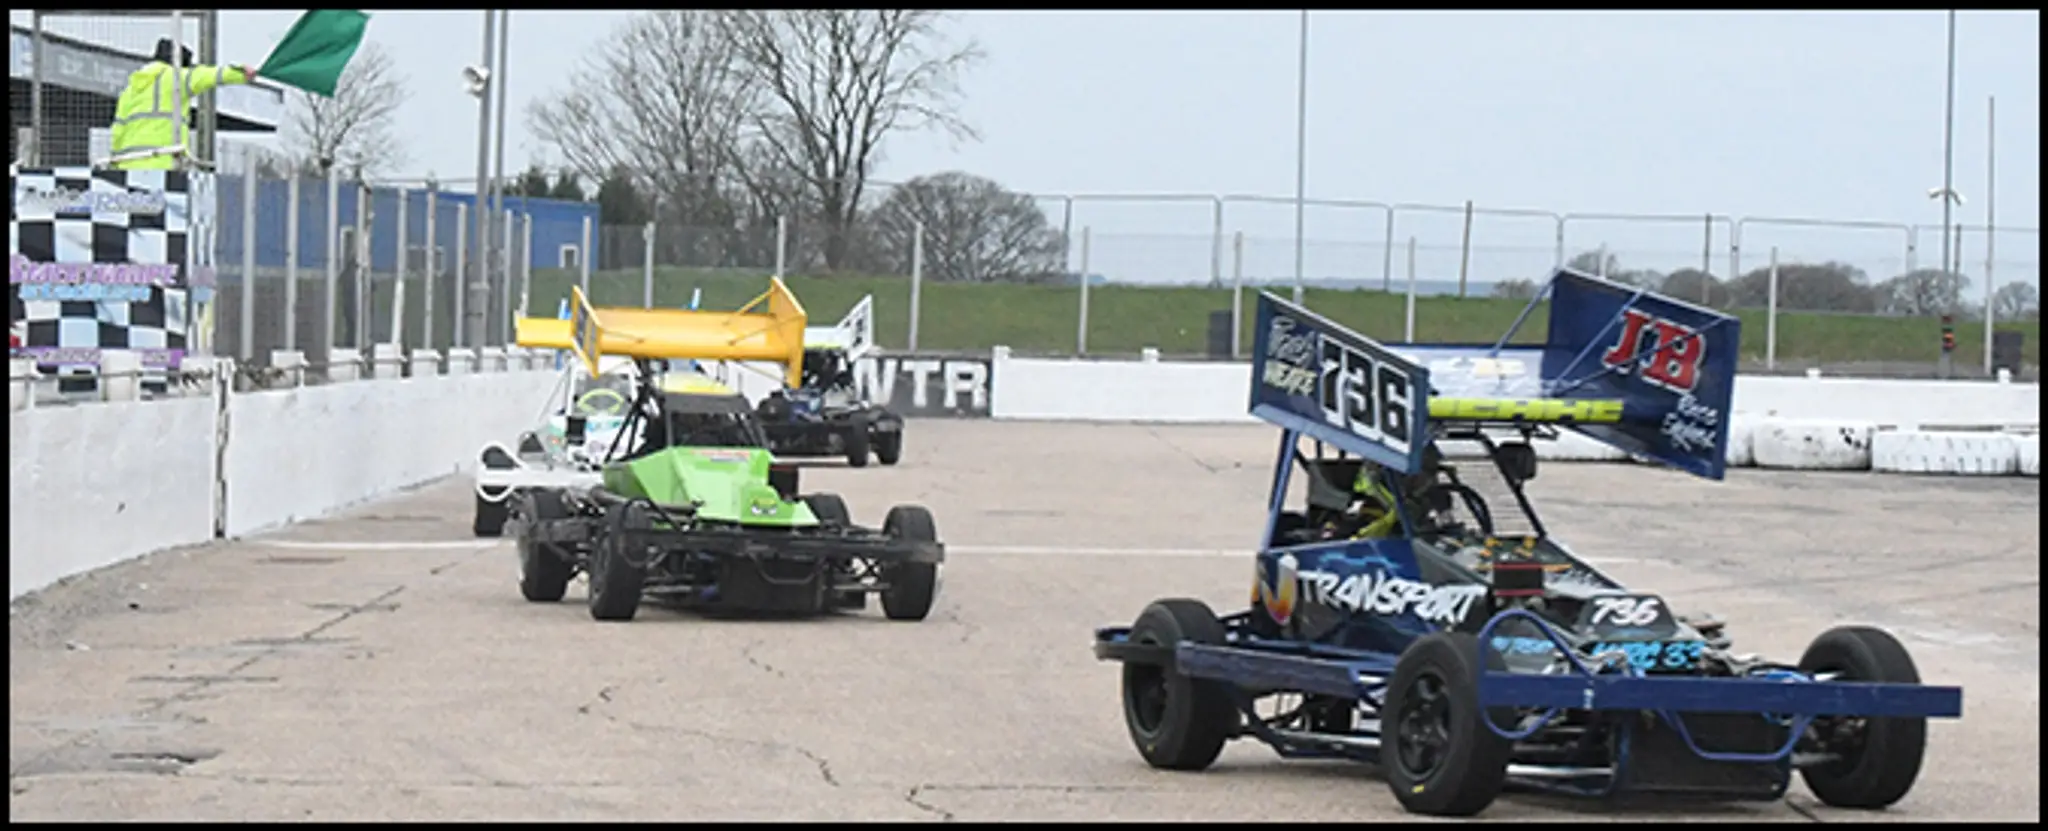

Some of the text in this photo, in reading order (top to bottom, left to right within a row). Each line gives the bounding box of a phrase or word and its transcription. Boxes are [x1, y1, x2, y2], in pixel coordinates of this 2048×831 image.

[1602, 308, 1707, 396] JB
[1317, 332, 1415, 454] 736
[1297, 569, 1488, 624] TRANSPORT
[1591, 597, 1661, 628] 736
